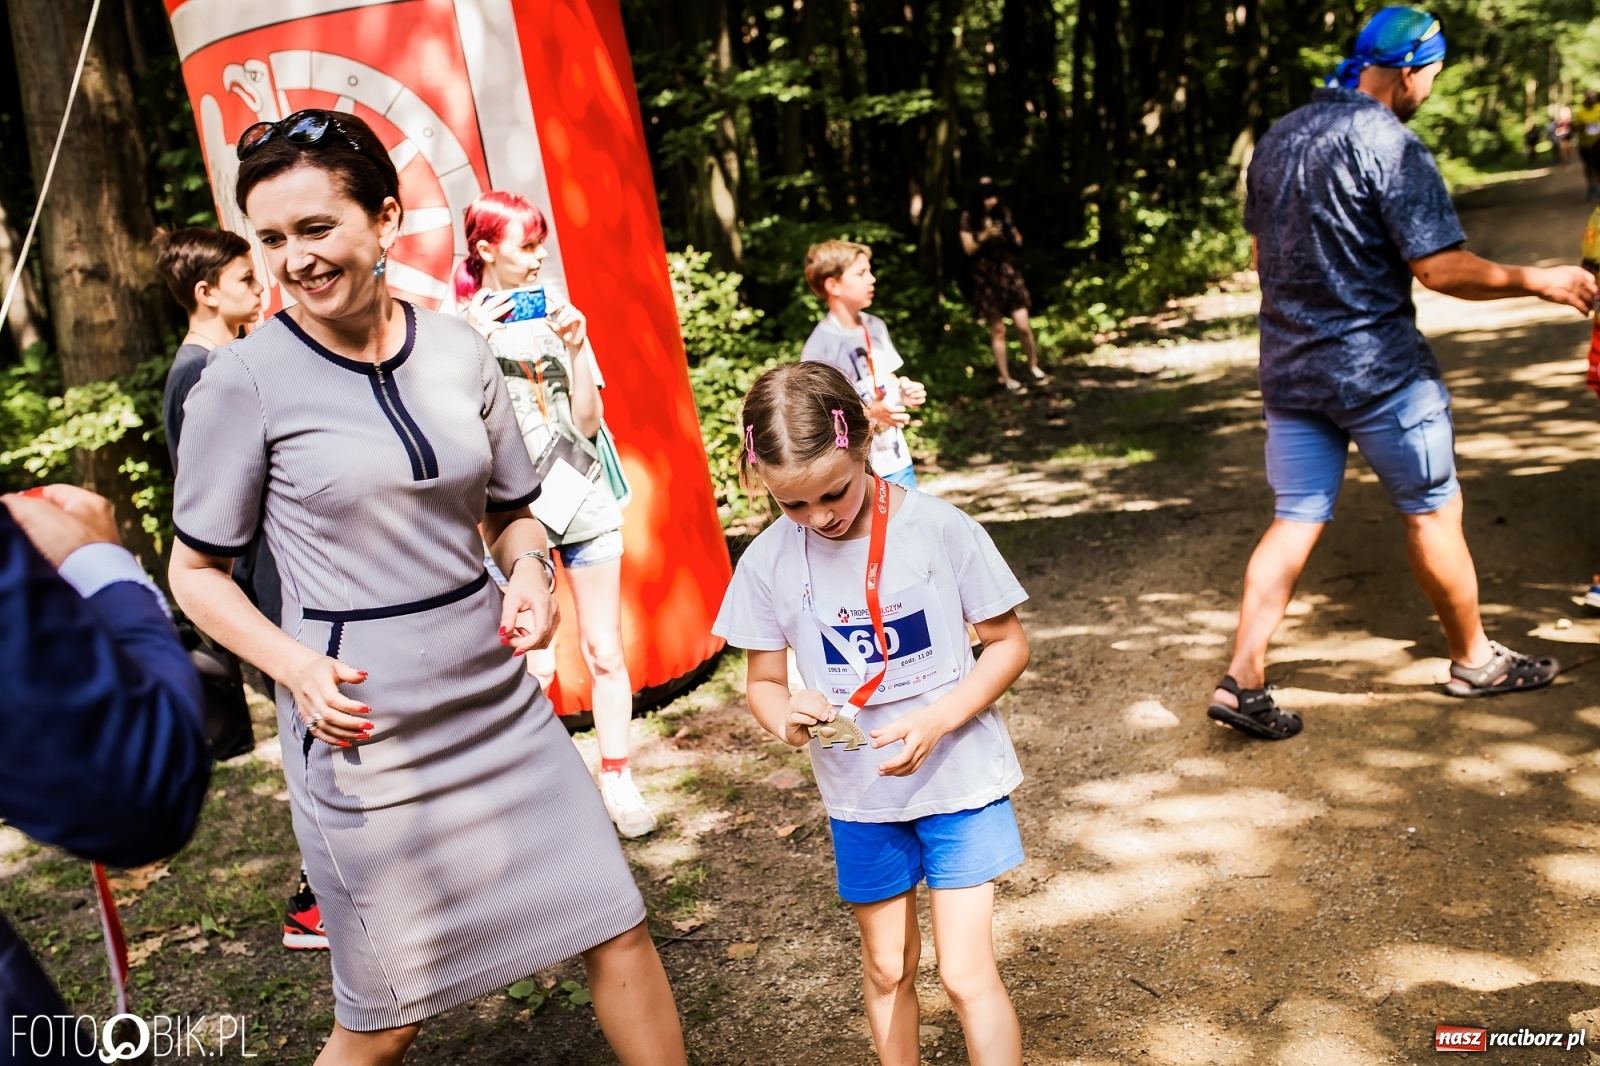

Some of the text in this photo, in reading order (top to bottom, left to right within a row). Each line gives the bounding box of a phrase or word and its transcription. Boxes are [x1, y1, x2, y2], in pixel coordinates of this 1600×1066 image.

[850, 608, 870, 617] TROPE
[881, 602, 902, 614] LCZYM
[849, 626, 900, 659] 60
[917, 649, 933, 661] 11.00
